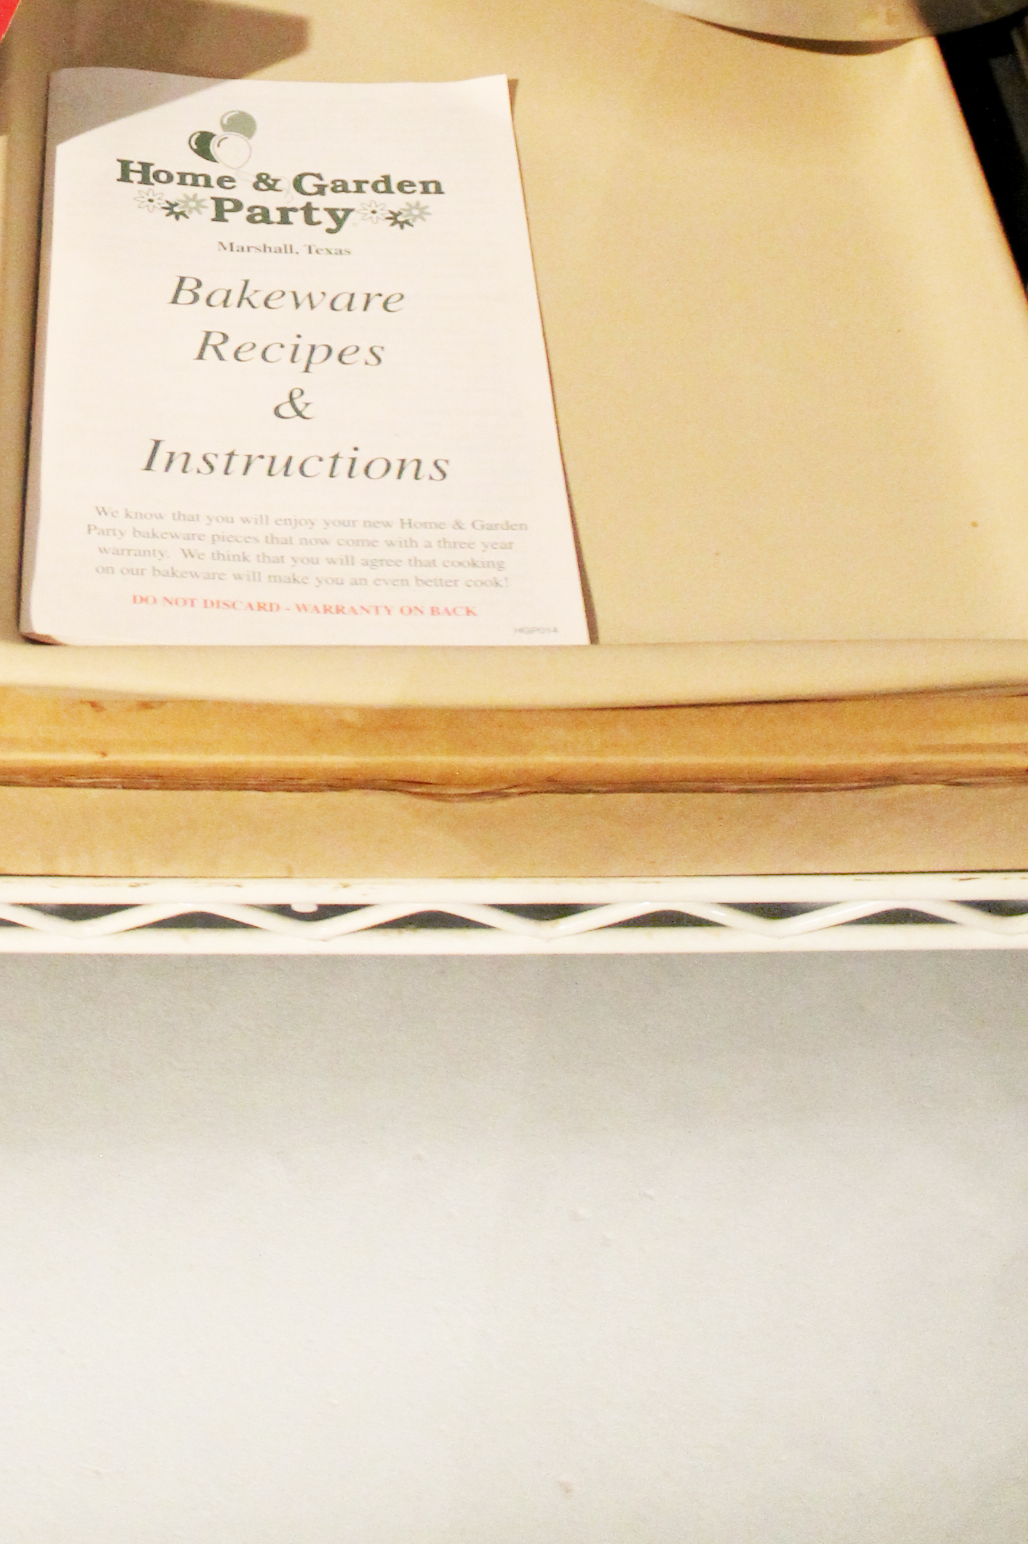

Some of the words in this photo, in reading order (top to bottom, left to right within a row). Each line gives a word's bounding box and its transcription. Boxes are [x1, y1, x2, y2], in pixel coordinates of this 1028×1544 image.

[116, 158, 237, 191] Home
[252, 172, 283, 192] &
[292, 172, 445, 196] Garden
[210, 196, 356, 234] Party
[218, 241, 299, 256] Marshall,
[303, 244, 353, 256] Texas
[166, 275, 405, 313] Bakeware
[193, 330, 386, 373] Recipes
[273, 387, 315, 421] &
[141, 438, 451, 483] Instructions
[95, 506, 119, 518] We
[124, 508, 166, 521] know
[172, 511, 200, 523] that
[205, 514, 234, 526] you
[240, 515, 269, 526] will
[274, 517, 316, 530] enjoy
[322, 519, 357, 530] your
[363, 520, 393, 529] new
[400, 519, 446, 530] Home
[452, 520, 466, 530] &
[471, 520, 529, 531] Garden
[86, 524, 126, 540] Party
[132, 527, 206, 542] bakeware
[211, 531, 260, 545] pieces
[264, 534, 293, 546] that
[299, 537, 330, 546] now
[337, 538, 379, 548] come
[384, 537, 419, 549] with
[423, 540, 433, 549] a
[437, 538, 476, 550] three
[481, 541, 514, 552] year
[98, 546, 171, 561] warranty.
[180, 547, 205, 560] We
[211, 550, 251, 563] think
[256, 552, 285, 564] that
[290, 555, 320, 567] you
[326, 555, 355, 566] will
[360, 558, 403, 570] agree
[408, 557, 437, 568] that
[442, 557, 505, 571] cooking
[95, 564, 115, 575] on
[120, 566, 146, 577] our
[152, 566, 226, 581] bakeware
[232, 571, 262, 583] will
[267, 573, 309, 585] make
[314, 576, 345, 588] you
[349, 577, 368, 586] an
[373, 577, 410, 587] even
[415, 575, 459, 588] better
[464, 576, 509, 588] cook!
[132, 594, 157, 605] DO
[162, 596, 198, 608] NOT
[203, 598, 281, 613] DISCARD
[295, 603, 394, 616] WARRANTY
[399, 606, 424, 616] ON
[430, 606, 478, 617] BACK
